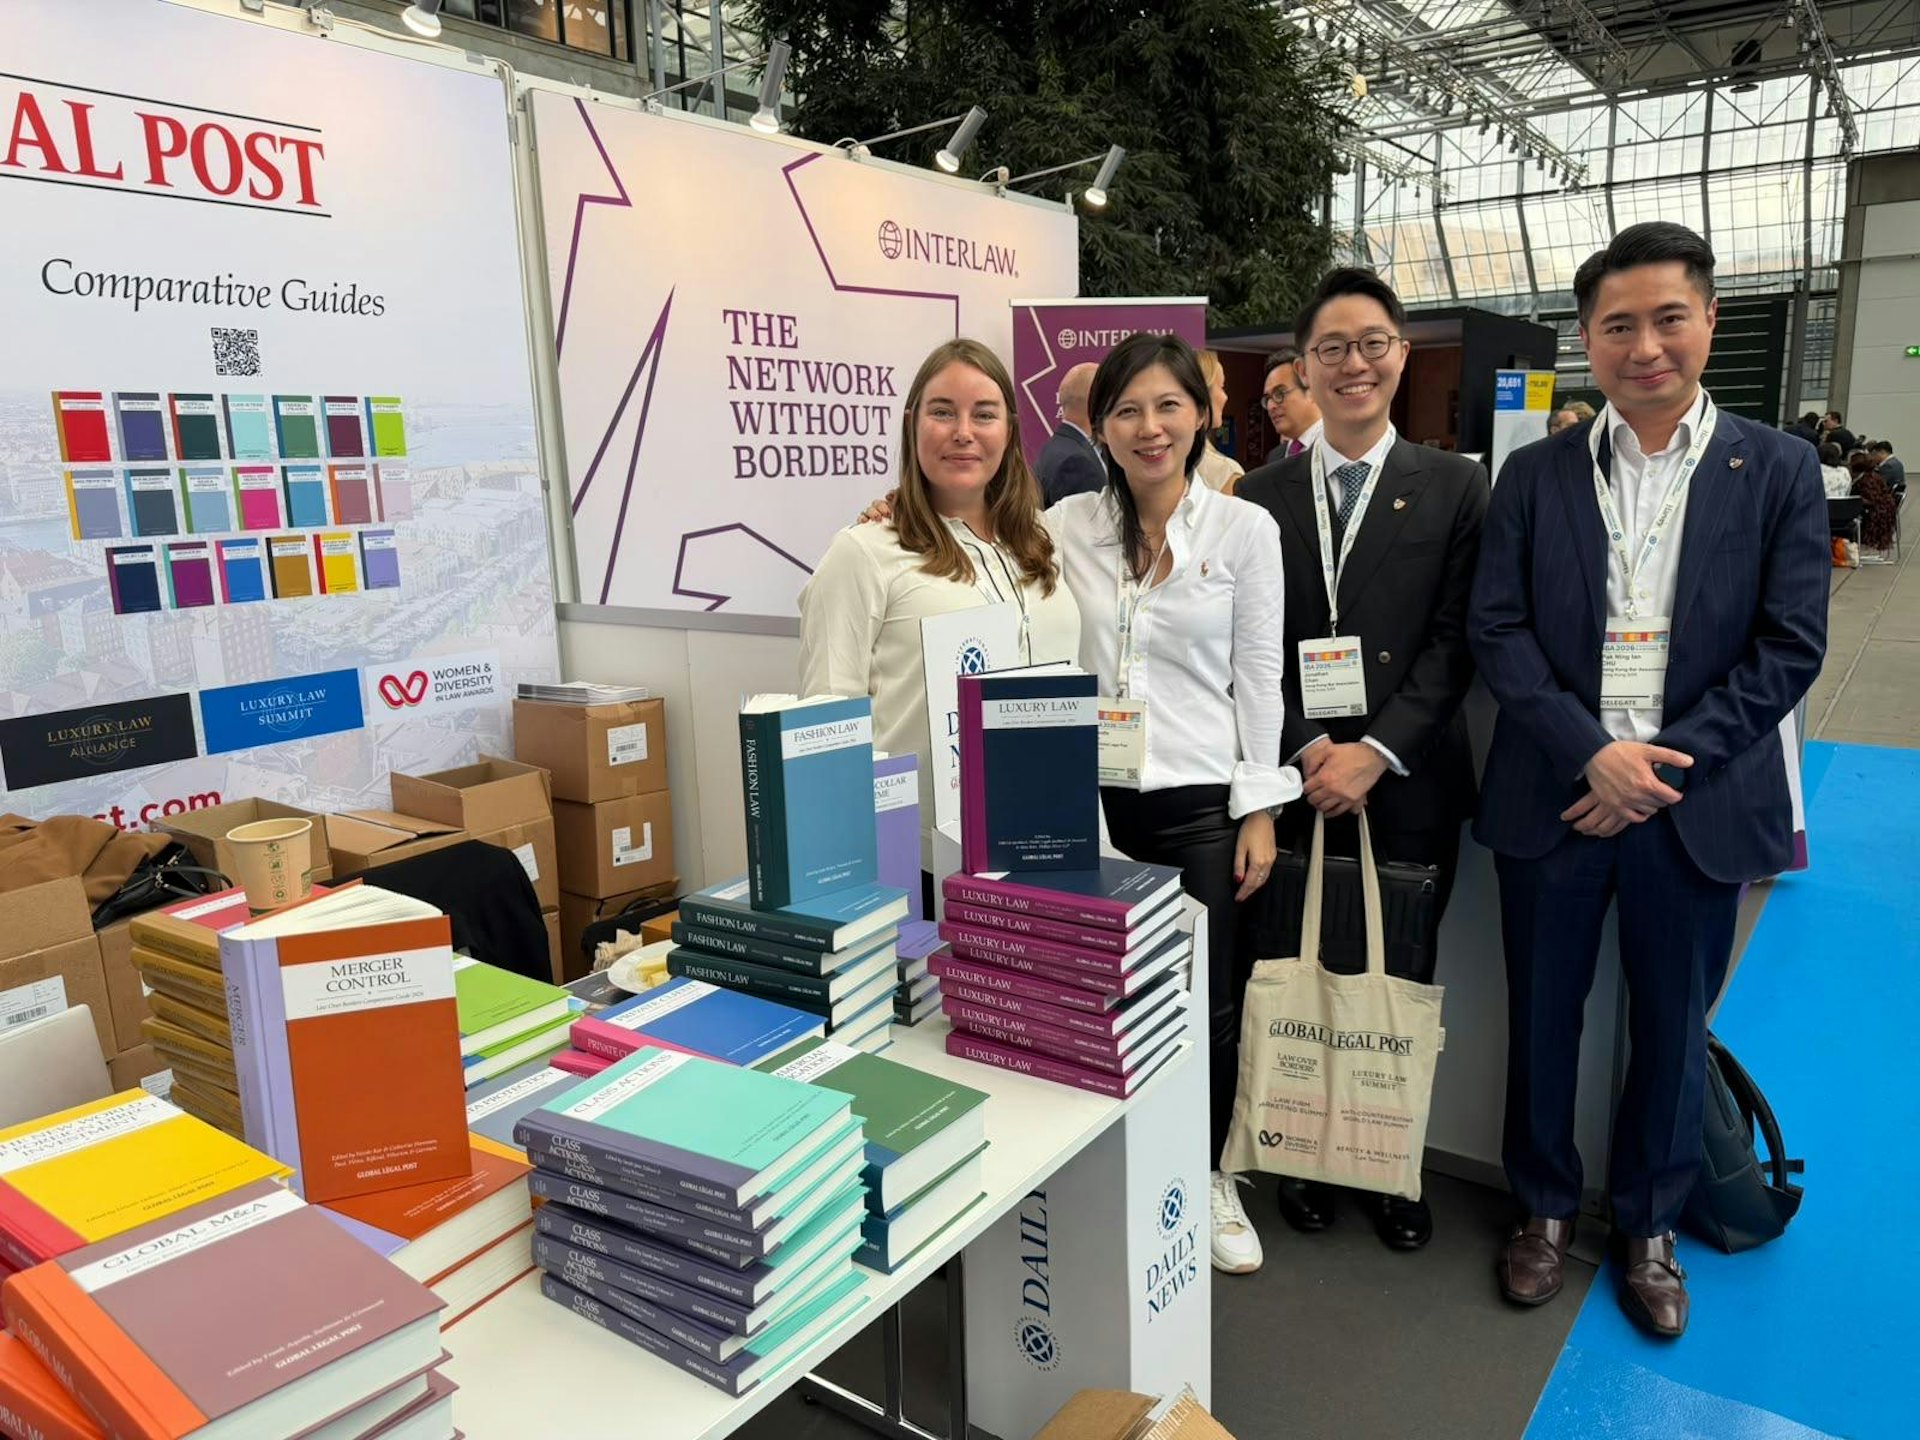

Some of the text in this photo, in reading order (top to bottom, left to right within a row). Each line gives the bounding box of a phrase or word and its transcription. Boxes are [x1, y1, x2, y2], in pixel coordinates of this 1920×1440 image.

[134, 112, 325, 207] POST
[41, 258, 386, 317] Comparative Guides
[723, 309, 798, 348] THE
[1079, 328, 1174, 348] INTER
[727, 355, 897, 397] NETWORK
[730, 401, 891, 436] WITHOUT
[733, 445, 889, 479] BORDERS
[433, 663, 491, 681] WOMEN &
[434, 675, 493, 693] DIVERSITY
[240, 688, 326, 713] LUXURY LAW
[435, 687, 494, 702] IN LAW AWARDS
[258, 707, 314, 726] SUMMIT
[999, 701, 1079, 713] LUXURY LAW
[48, 716, 152, 743] LUXURY LAW
[794, 722, 860, 742] FASHION LAW
[70, 737, 137, 759] ALLIANCE
[745, 739, 760, 818] FASHION LAW
[962, 889, 1030, 909] LUXURY LAW
[696, 912, 757, 932] FASHION LAW
[963, 910, 1031, 931] LUXURY LAW
[687, 932, 748, 954] FASHION LAW
[958, 932, 1026, 954] LUXURY LAW
[331, 957, 403, 978] MERGER
[970, 948, 1034, 971] LUXURY LAW
[326, 972, 411, 992] CONTROL
[685, 965, 750, 985] FASHION LAW
[946, 967, 1012, 990] LUXURY LAW
[958, 987, 1022, 1011] LUXURY LAW
[961, 1007, 1027, 1032] LUXURY LAW
[969, 1022, 1033, 1048] LUXURY LAW
[1269, 1021, 1413, 1055] GLOBAL LEGAL POST
[587, 1038, 618, 1057] PRIVATE
[965, 1047, 1032, 1071] LUXURY LAW
[1277, 1052, 1318, 1066] LAW OVER
[1279, 1060, 1315, 1073] BORDERS
[574, 1054, 672, 1113] CLASS ACTIONS
[1352, 1070, 1407, 1083] LUXURY LAW
[1360, 1080, 1397, 1091] SUMMIT
[1274, 1096, 1290, 1105] LAW
[552, 1134, 581, 1151] CLASS
[1285, 1135, 1313, 1145] WOMEN
[1336, 1145, 1364, 1155] BEAUTY
[549, 1144, 589, 1165] ACTIONS
[357, 1170, 382, 1179] GLOBAL
[565, 1166, 604, 1185] ACTIONS
[569, 1184, 600, 1202] CLASS
[567, 1195, 608, 1214] ACTIONS
[103, 1202, 268, 1270] GLOBAL M&A
[572, 1223, 601, 1241] CLASS
[570, 1234, 608, 1254] ACTIONS
[568, 1250, 597, 1269] CLASS
[1145, 1223, 1199, 1294] DAILY
[1148, 1257, 1197, 1323] NEWS
[574, 1294, 600, 1314] CLASS
[18, 1318, 51, 1367] GLOBAL
[275, 1323, 362, 1369] GLOBAL LEGAL POST
